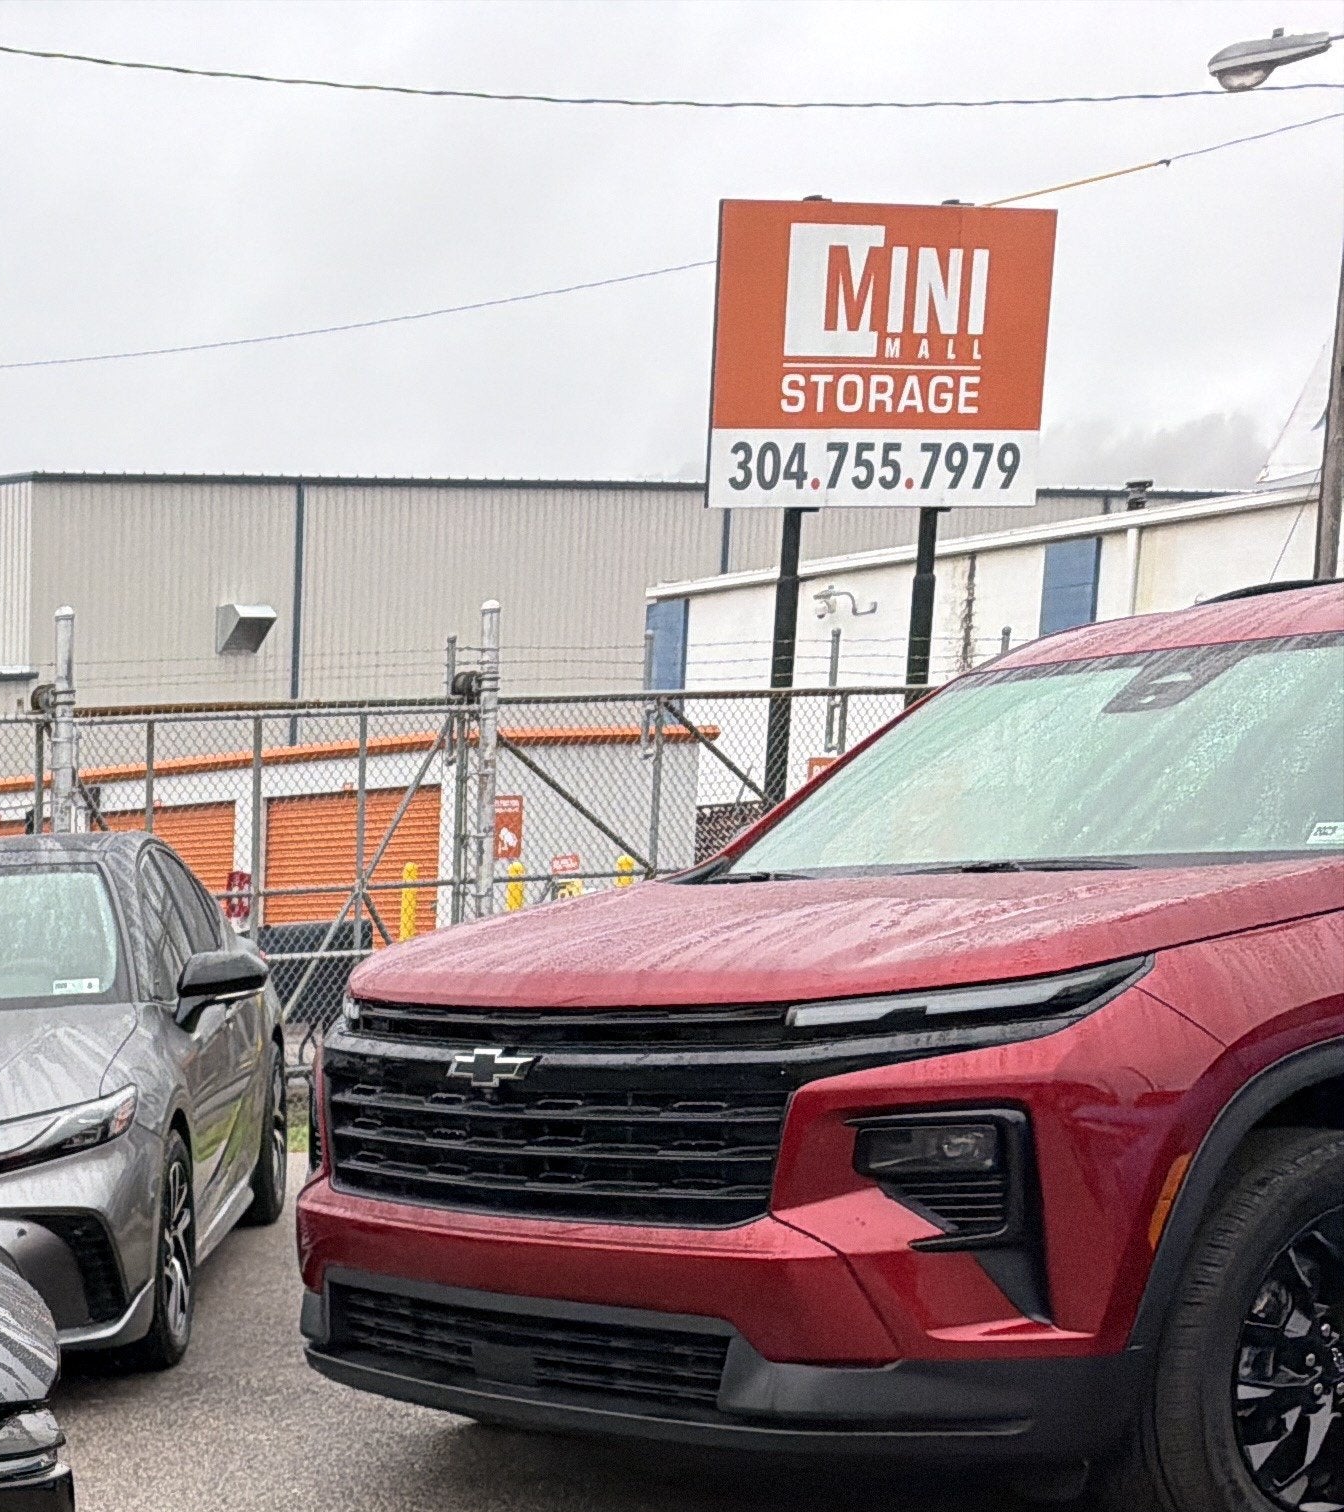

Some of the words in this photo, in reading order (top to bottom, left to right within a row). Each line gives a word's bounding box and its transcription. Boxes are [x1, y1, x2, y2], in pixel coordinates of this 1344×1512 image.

[820, 242, 992, 337] MINI
[883, 337, 982, 361] MALL
[779, 373, 981, 414] STORAGE
[727, 441, 1021, 491] 304.755.7979
